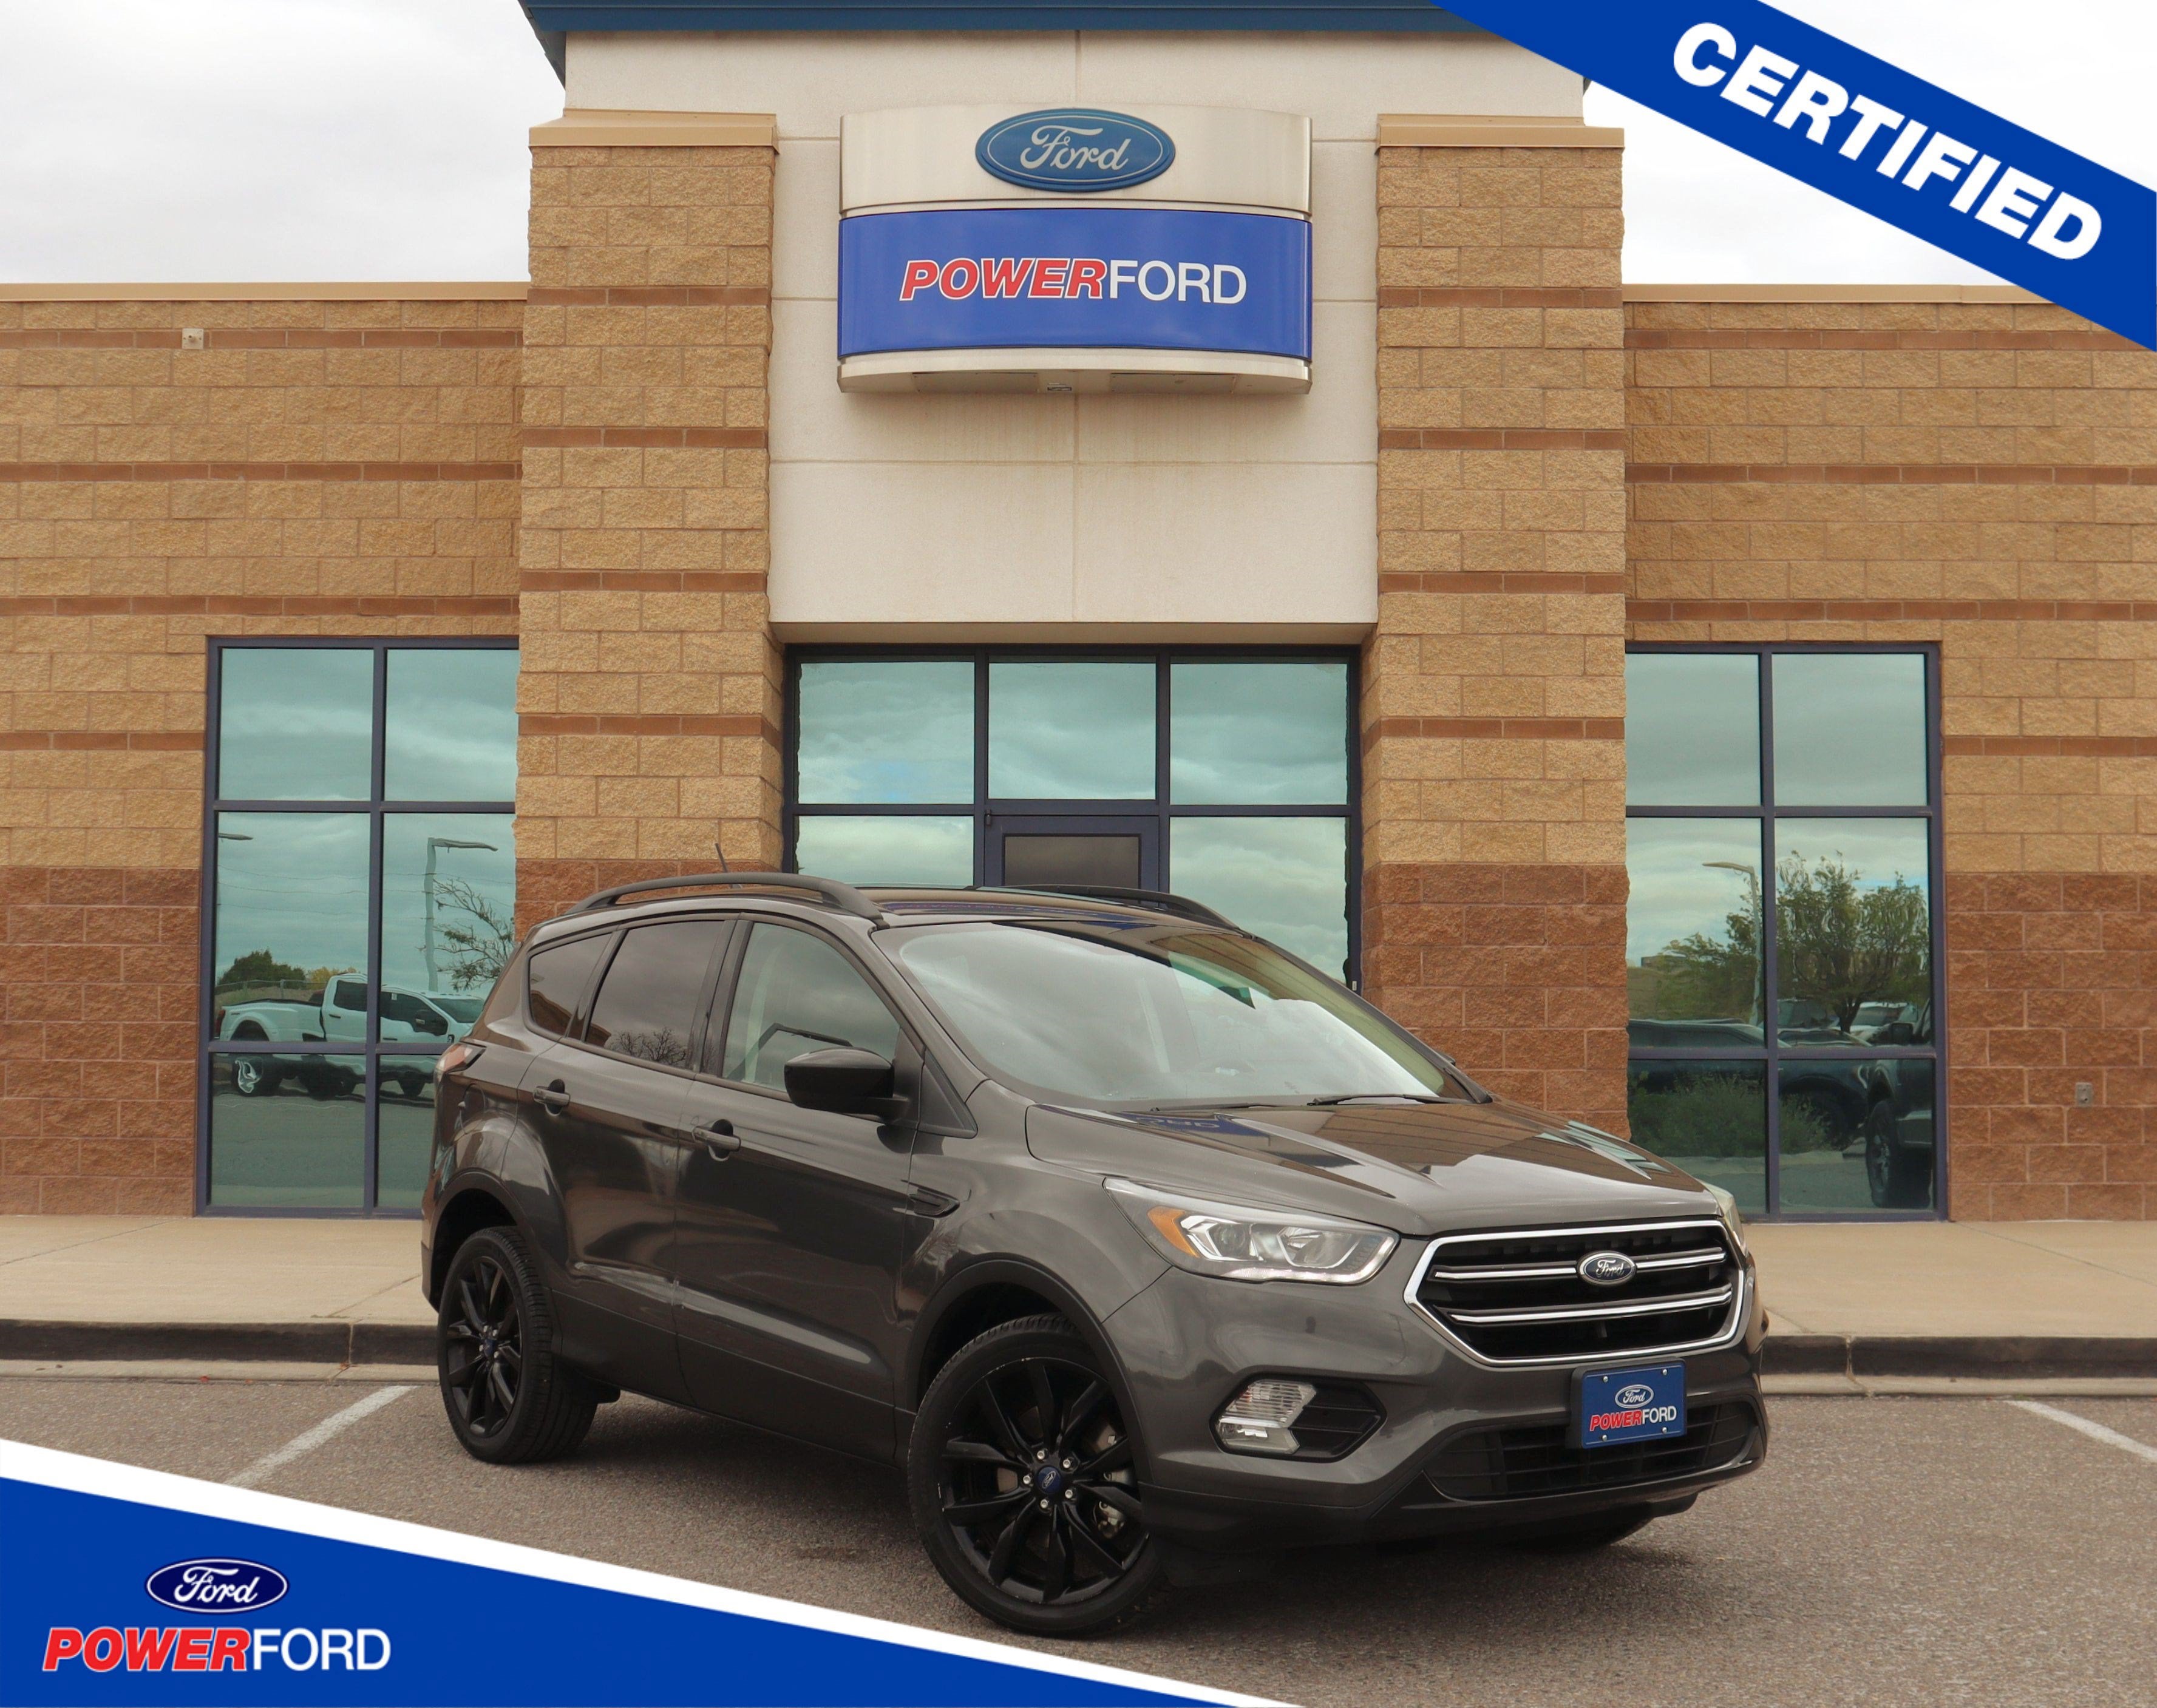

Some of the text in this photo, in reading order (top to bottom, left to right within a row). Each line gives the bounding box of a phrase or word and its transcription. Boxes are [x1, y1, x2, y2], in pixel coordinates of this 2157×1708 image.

[1020, 124, 1130, 171] Ford
[898, 257, 1247, 305] POWERFORD
[1595, 1259, 1624, 1277] Ford
[1622, 1389, 1646, 1405] Ford
[1589, 1405, 1677, 1432] POWERFORD
